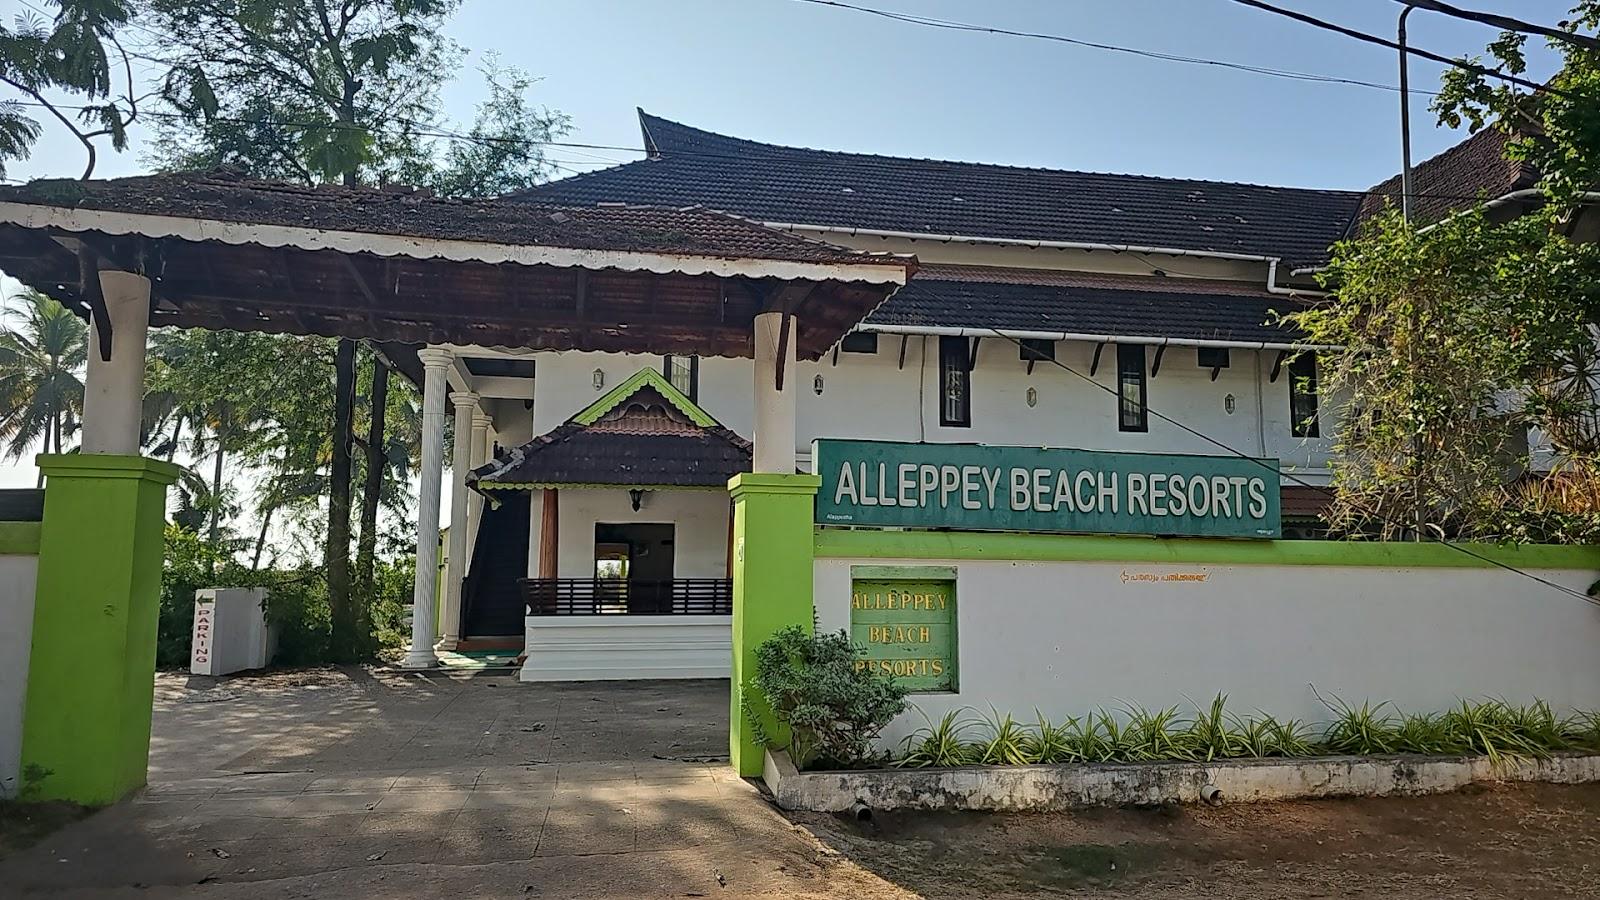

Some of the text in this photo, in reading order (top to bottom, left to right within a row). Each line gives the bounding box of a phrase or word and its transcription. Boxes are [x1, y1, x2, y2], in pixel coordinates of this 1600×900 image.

[834, 461, 1267, 519] ALLEPPEY BEACH RESORTS
[851, 592, 947, 611] ALLEPPEY
[195, 609, 211, 663] PARKING
[868, 625, 931, 644] BEACH
